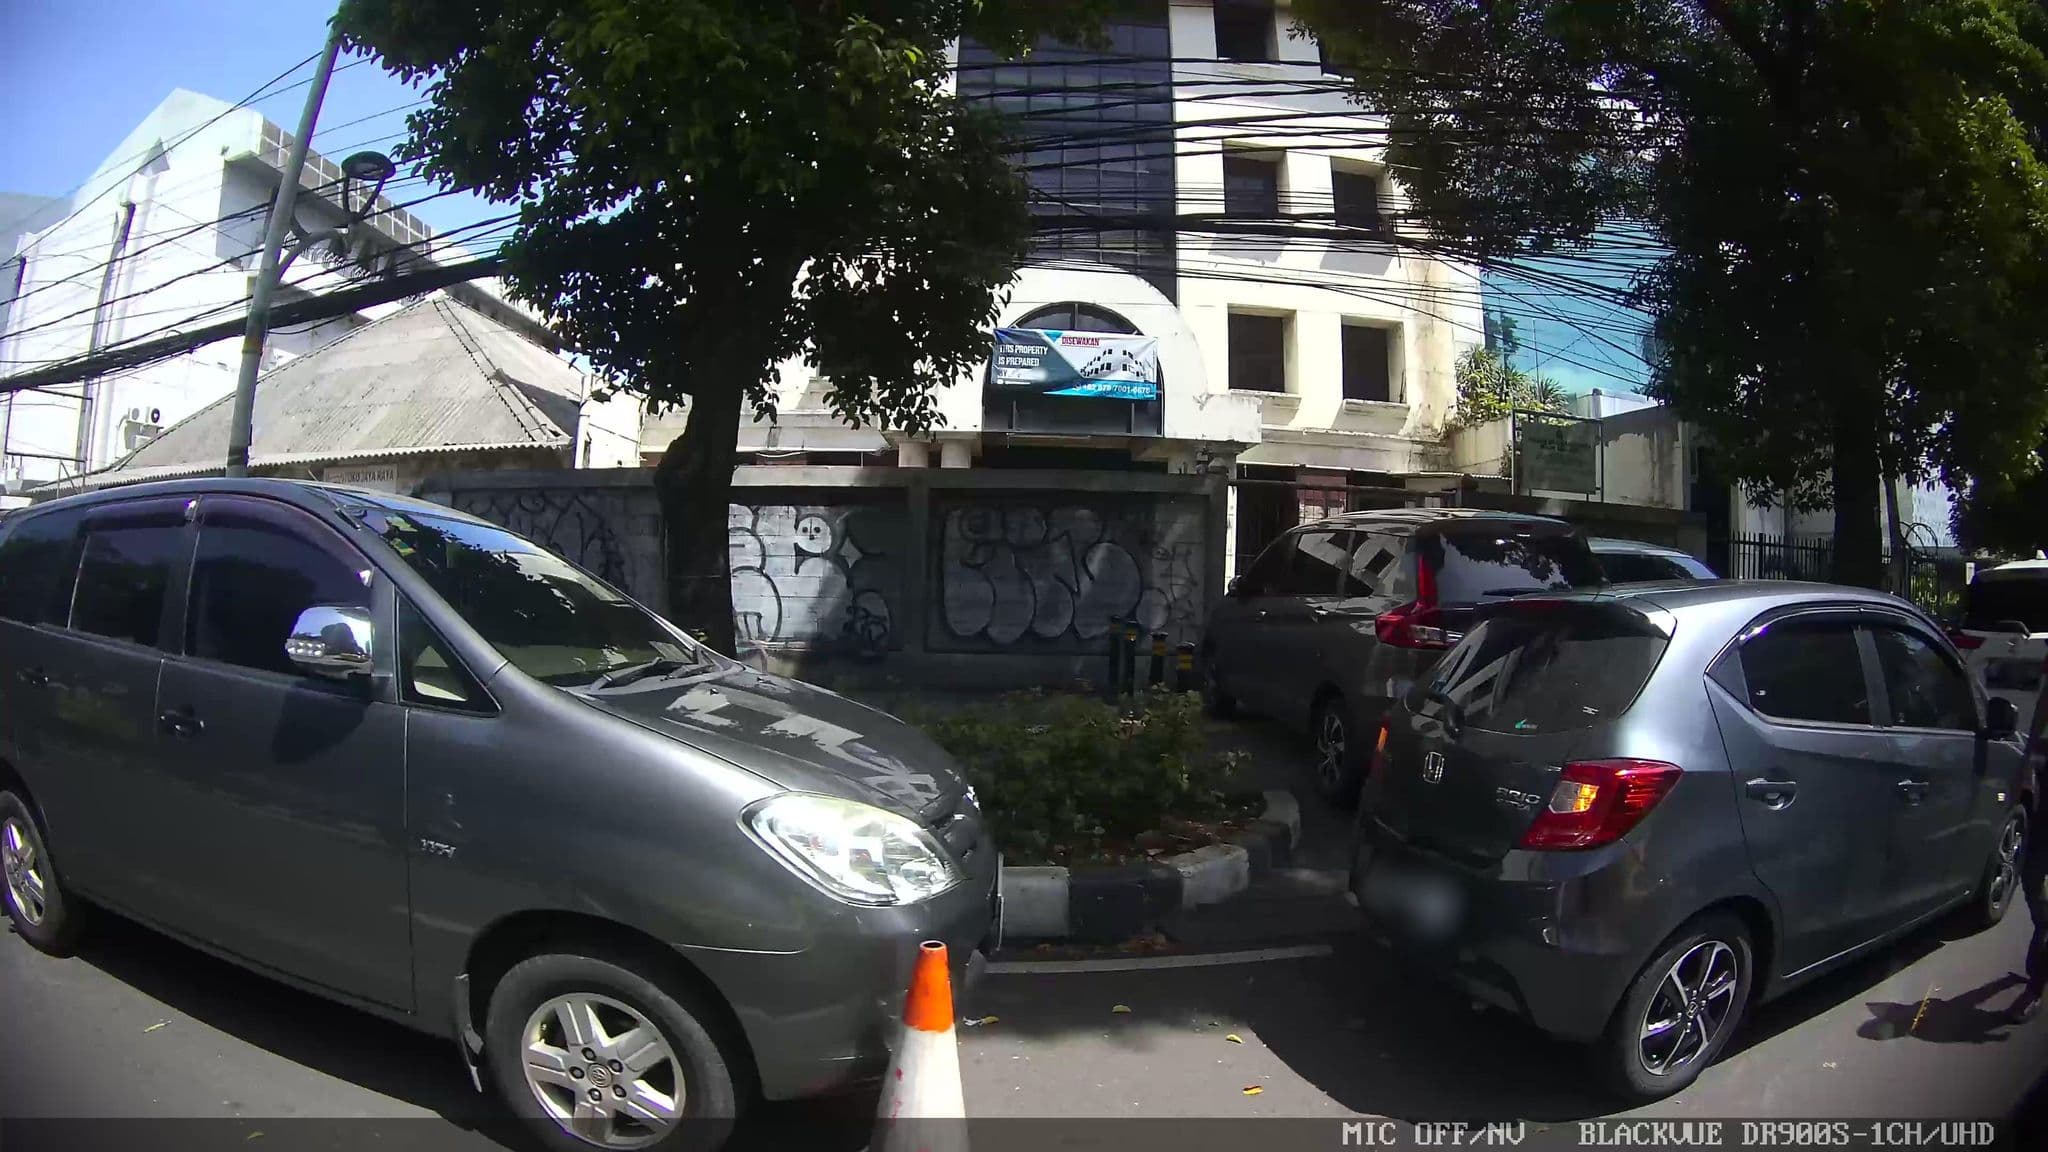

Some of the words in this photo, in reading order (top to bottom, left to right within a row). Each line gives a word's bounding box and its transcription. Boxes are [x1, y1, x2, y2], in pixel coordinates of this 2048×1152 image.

[1061, 336, 1100, 346] DISEWAKAN
[1014, 345, 1048, 355] PROPERTY
[998, 356, 1005, 365] IS
[1006, 357, 1040, 367] PREPARED
